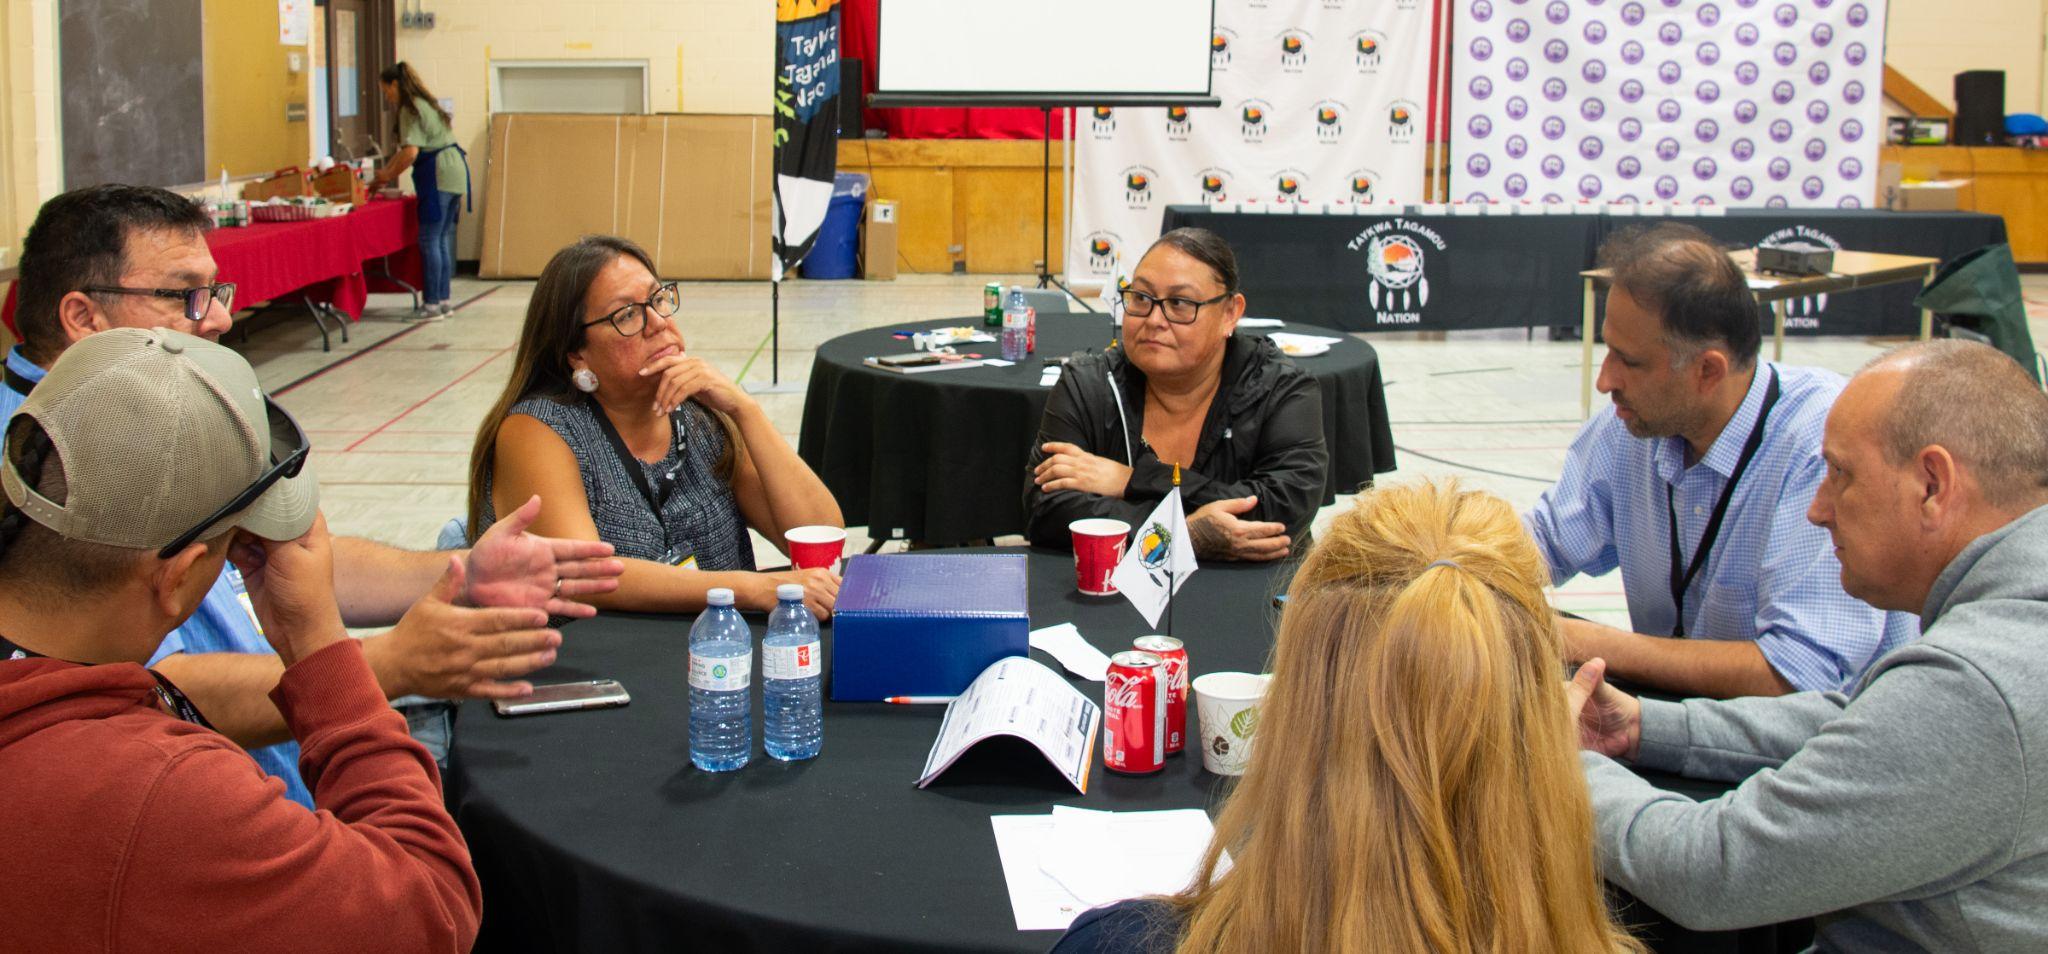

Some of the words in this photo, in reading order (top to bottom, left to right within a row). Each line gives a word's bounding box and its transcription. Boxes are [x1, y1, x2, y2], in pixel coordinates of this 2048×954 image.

[1347, 220, 1392, 251] TAYKWA
[1394, 218, 1447, 251] TAGAMOU
[1795, 225, 1841, 250] TAGAMO
[1376, 311, 1420, 324] NATION
[1783, 317, 1819, 329] ATION
